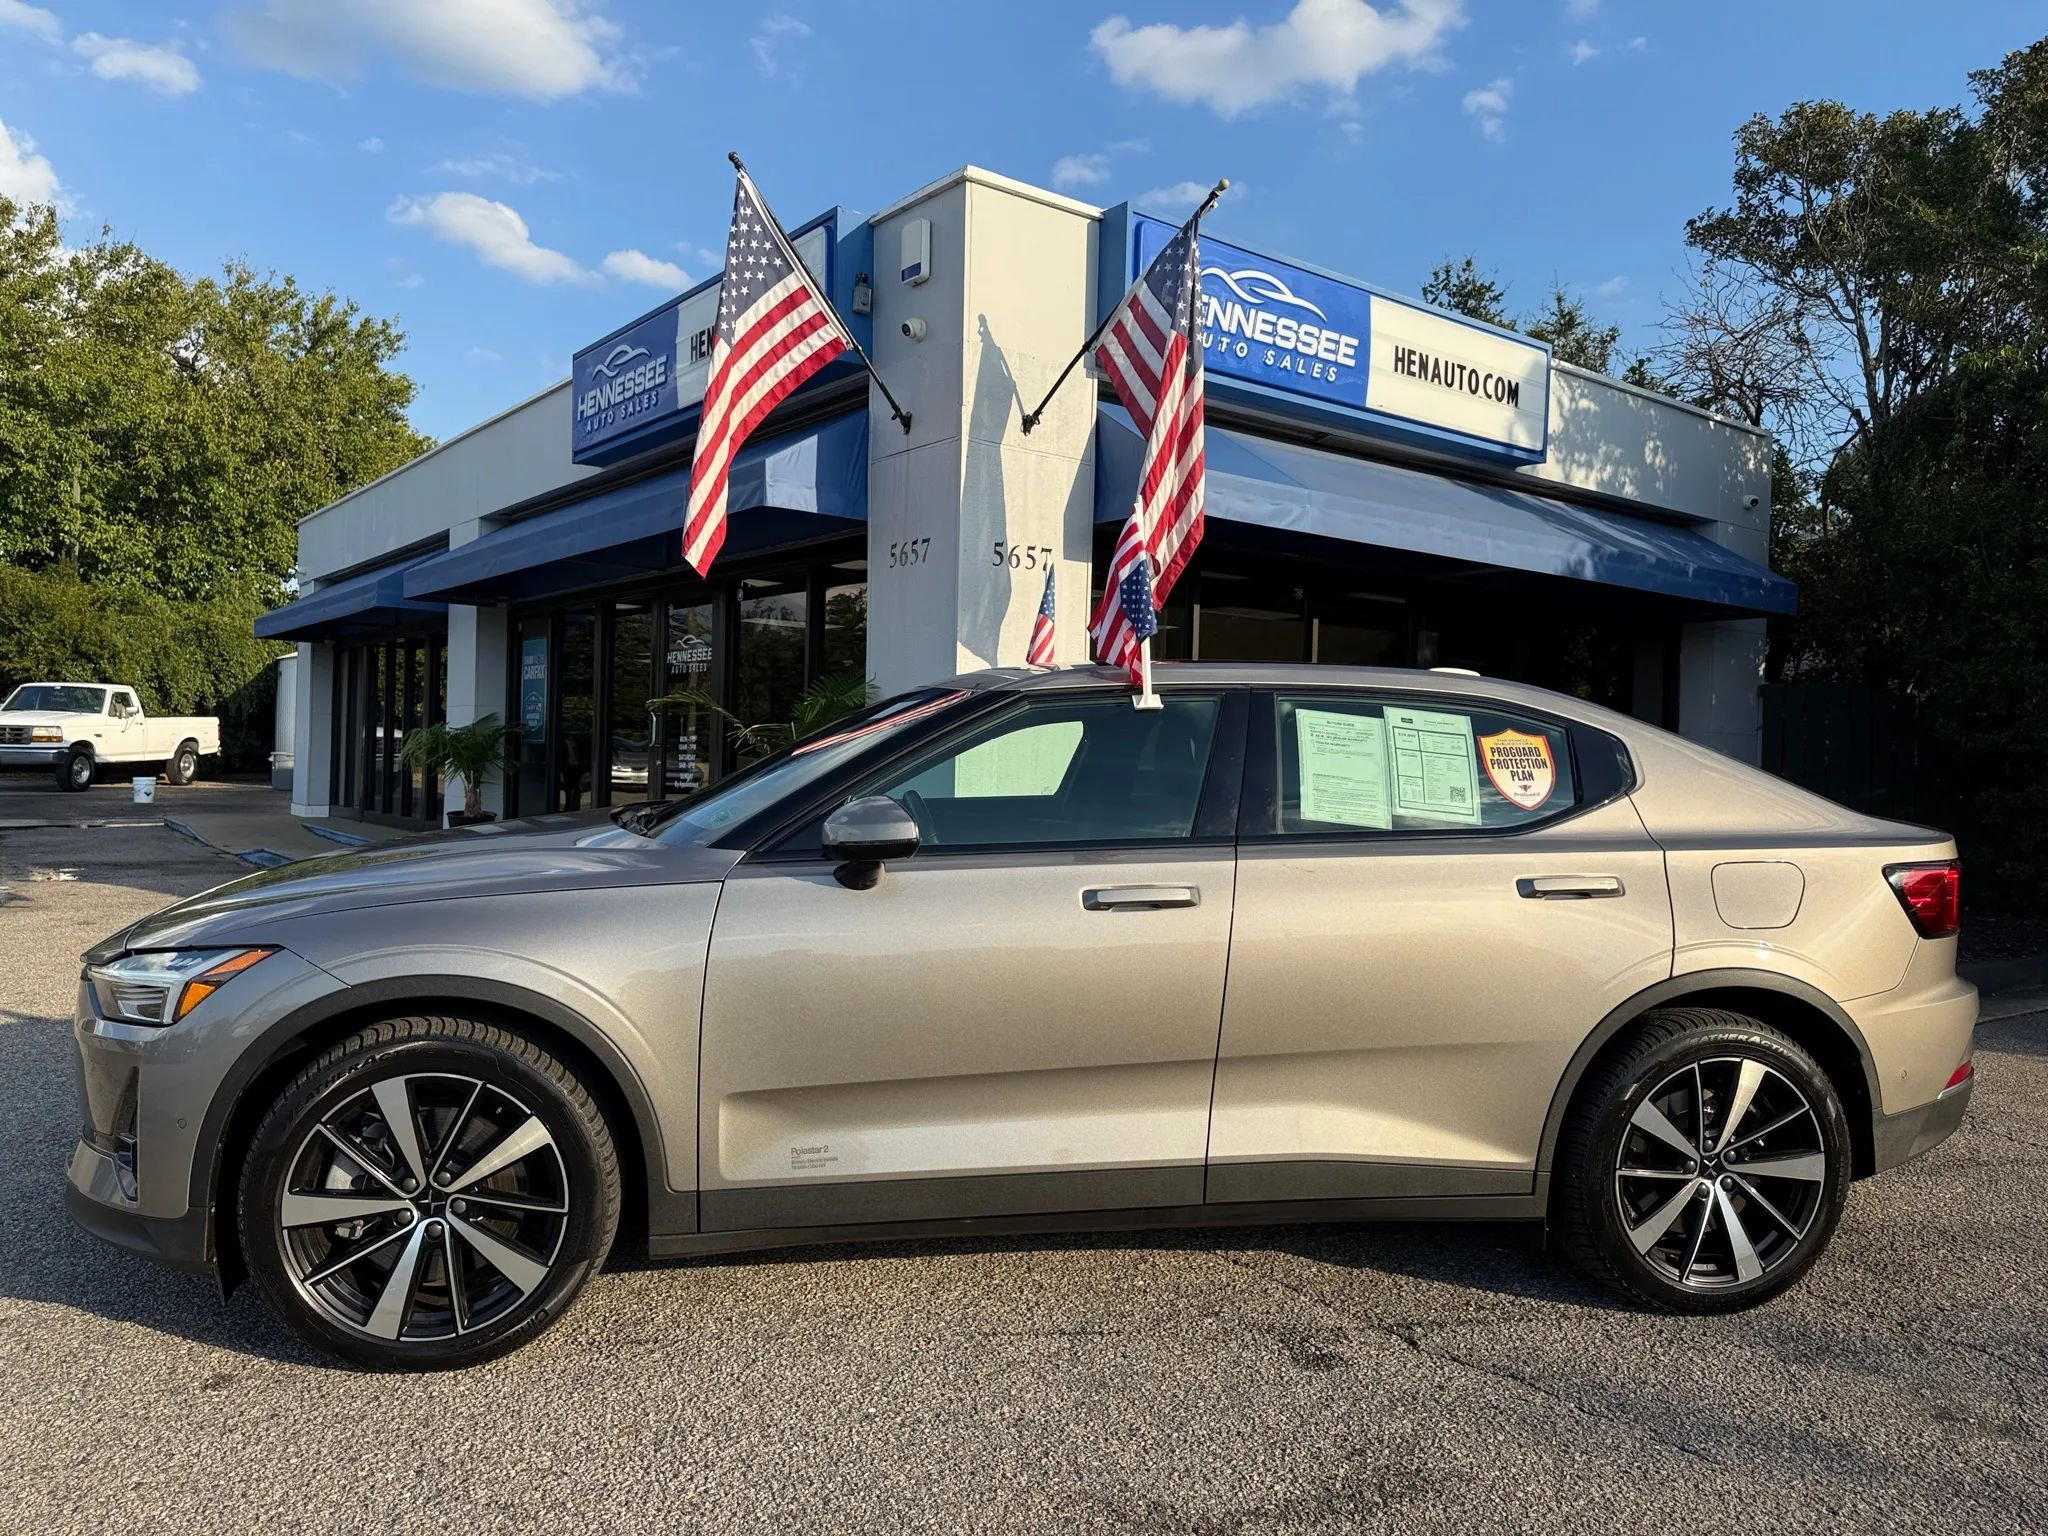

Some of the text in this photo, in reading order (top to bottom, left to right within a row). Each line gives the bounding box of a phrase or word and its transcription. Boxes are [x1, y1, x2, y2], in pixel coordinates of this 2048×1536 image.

[1202, 294, 1359, 368] NNESSEE
[1202, 332, 1338, 383] UTO SALES
[577, 354, 669, 422] HENNESSEE
[585, 391, 658, 434] AUTO SALES
[889, 537, 931, 569] 5657
[992, 541, 1053, 572] 5657
[667, 648, 713, 664] HENNESSEE
[1490, 746, 1542, 758] PROGUARD
[1490, 758, 1549, 770] PROTECTION
[1510, 770, 1535, 782] PLAN
[791, 1144, 829, 1156] Polestar 2
